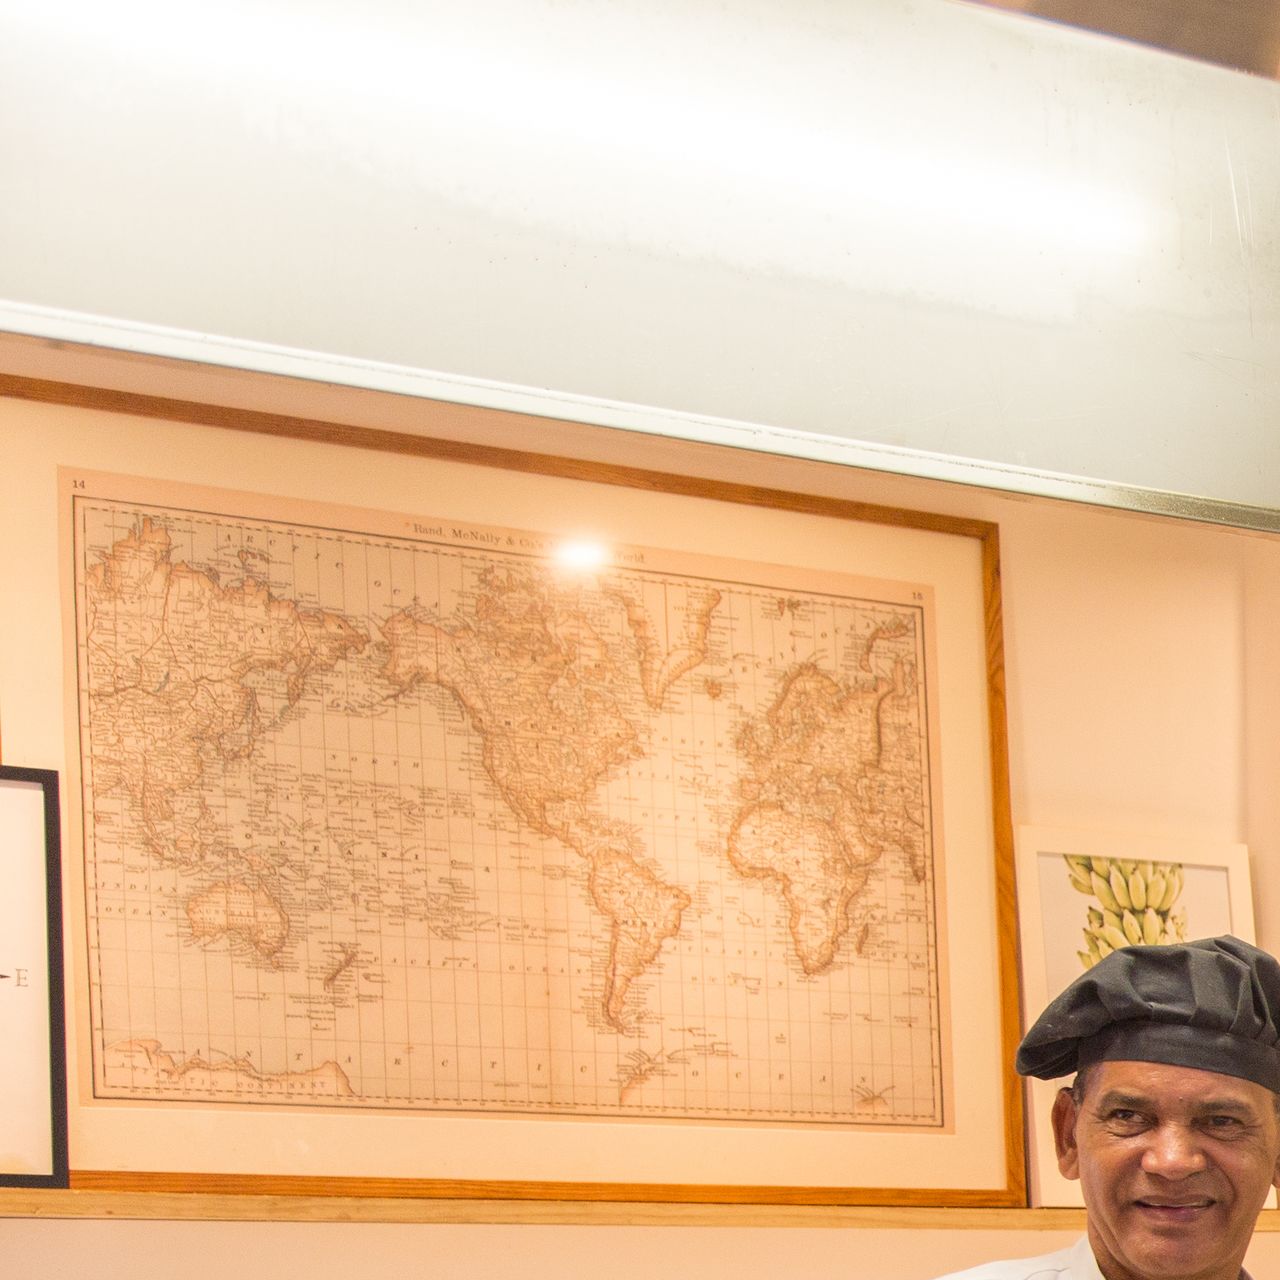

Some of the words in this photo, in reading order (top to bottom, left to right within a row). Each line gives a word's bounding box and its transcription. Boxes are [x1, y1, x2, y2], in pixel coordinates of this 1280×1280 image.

[72, 480, 86, 489] 14
[451, 528, 501, 545] McNally
[506, 535, 514, 546] &
[15, 968, 29, 988] E
